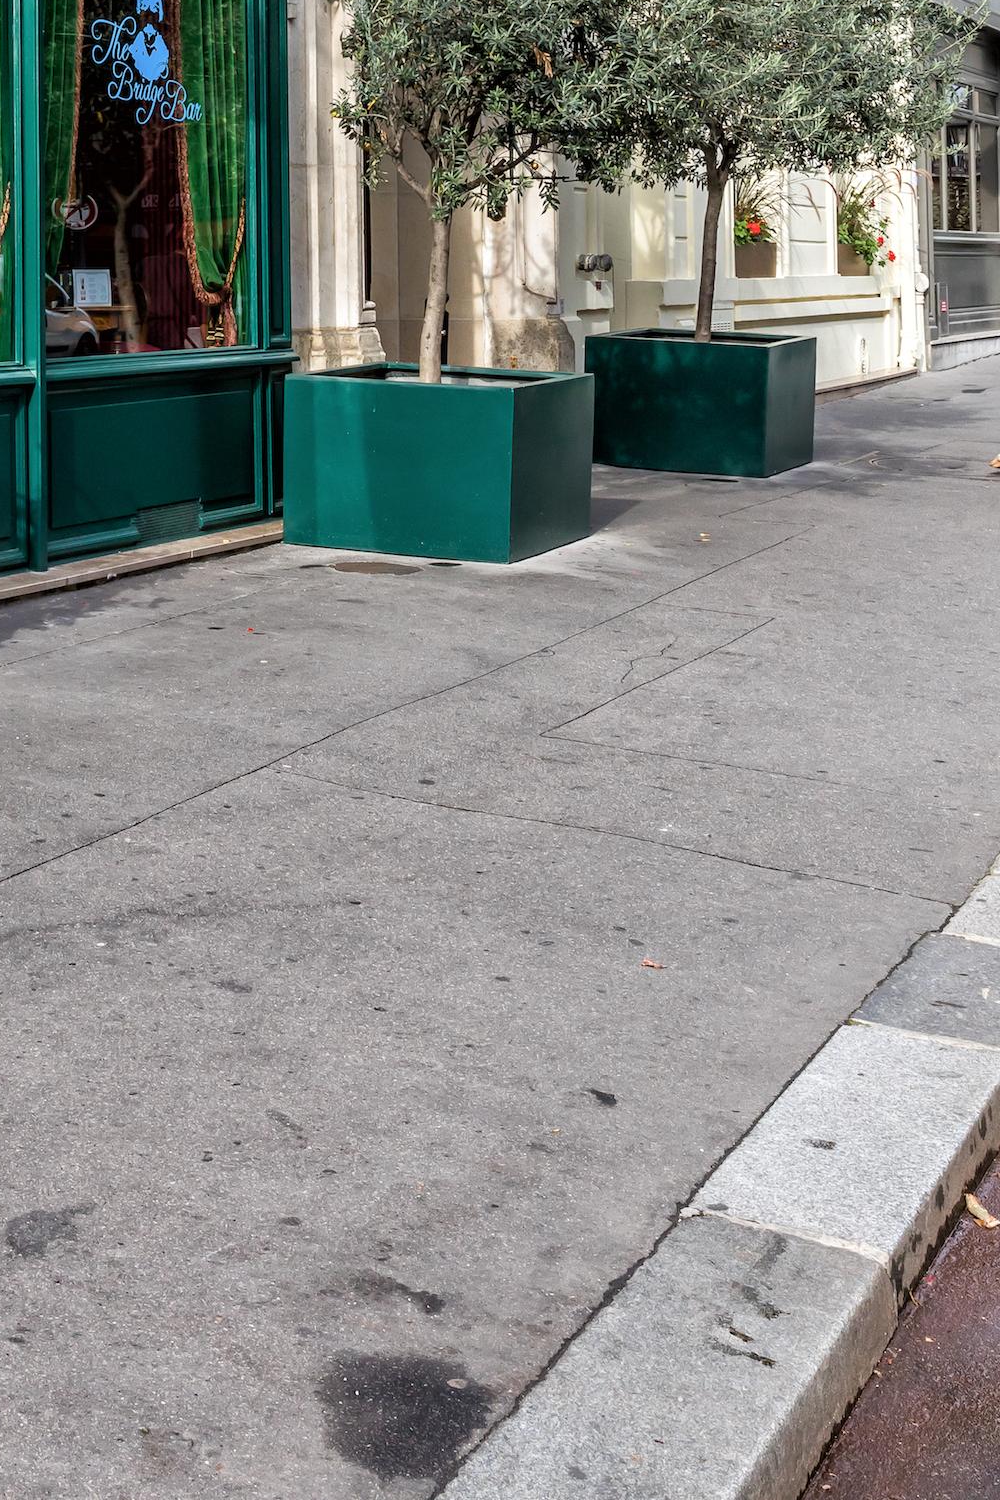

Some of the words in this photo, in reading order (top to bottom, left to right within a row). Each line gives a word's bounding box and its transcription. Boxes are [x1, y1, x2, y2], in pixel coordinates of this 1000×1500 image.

[91, 16, 137, 64] The
[107, 60, 169, 125] Bridge
[160, 79, 203, 122] Bar
